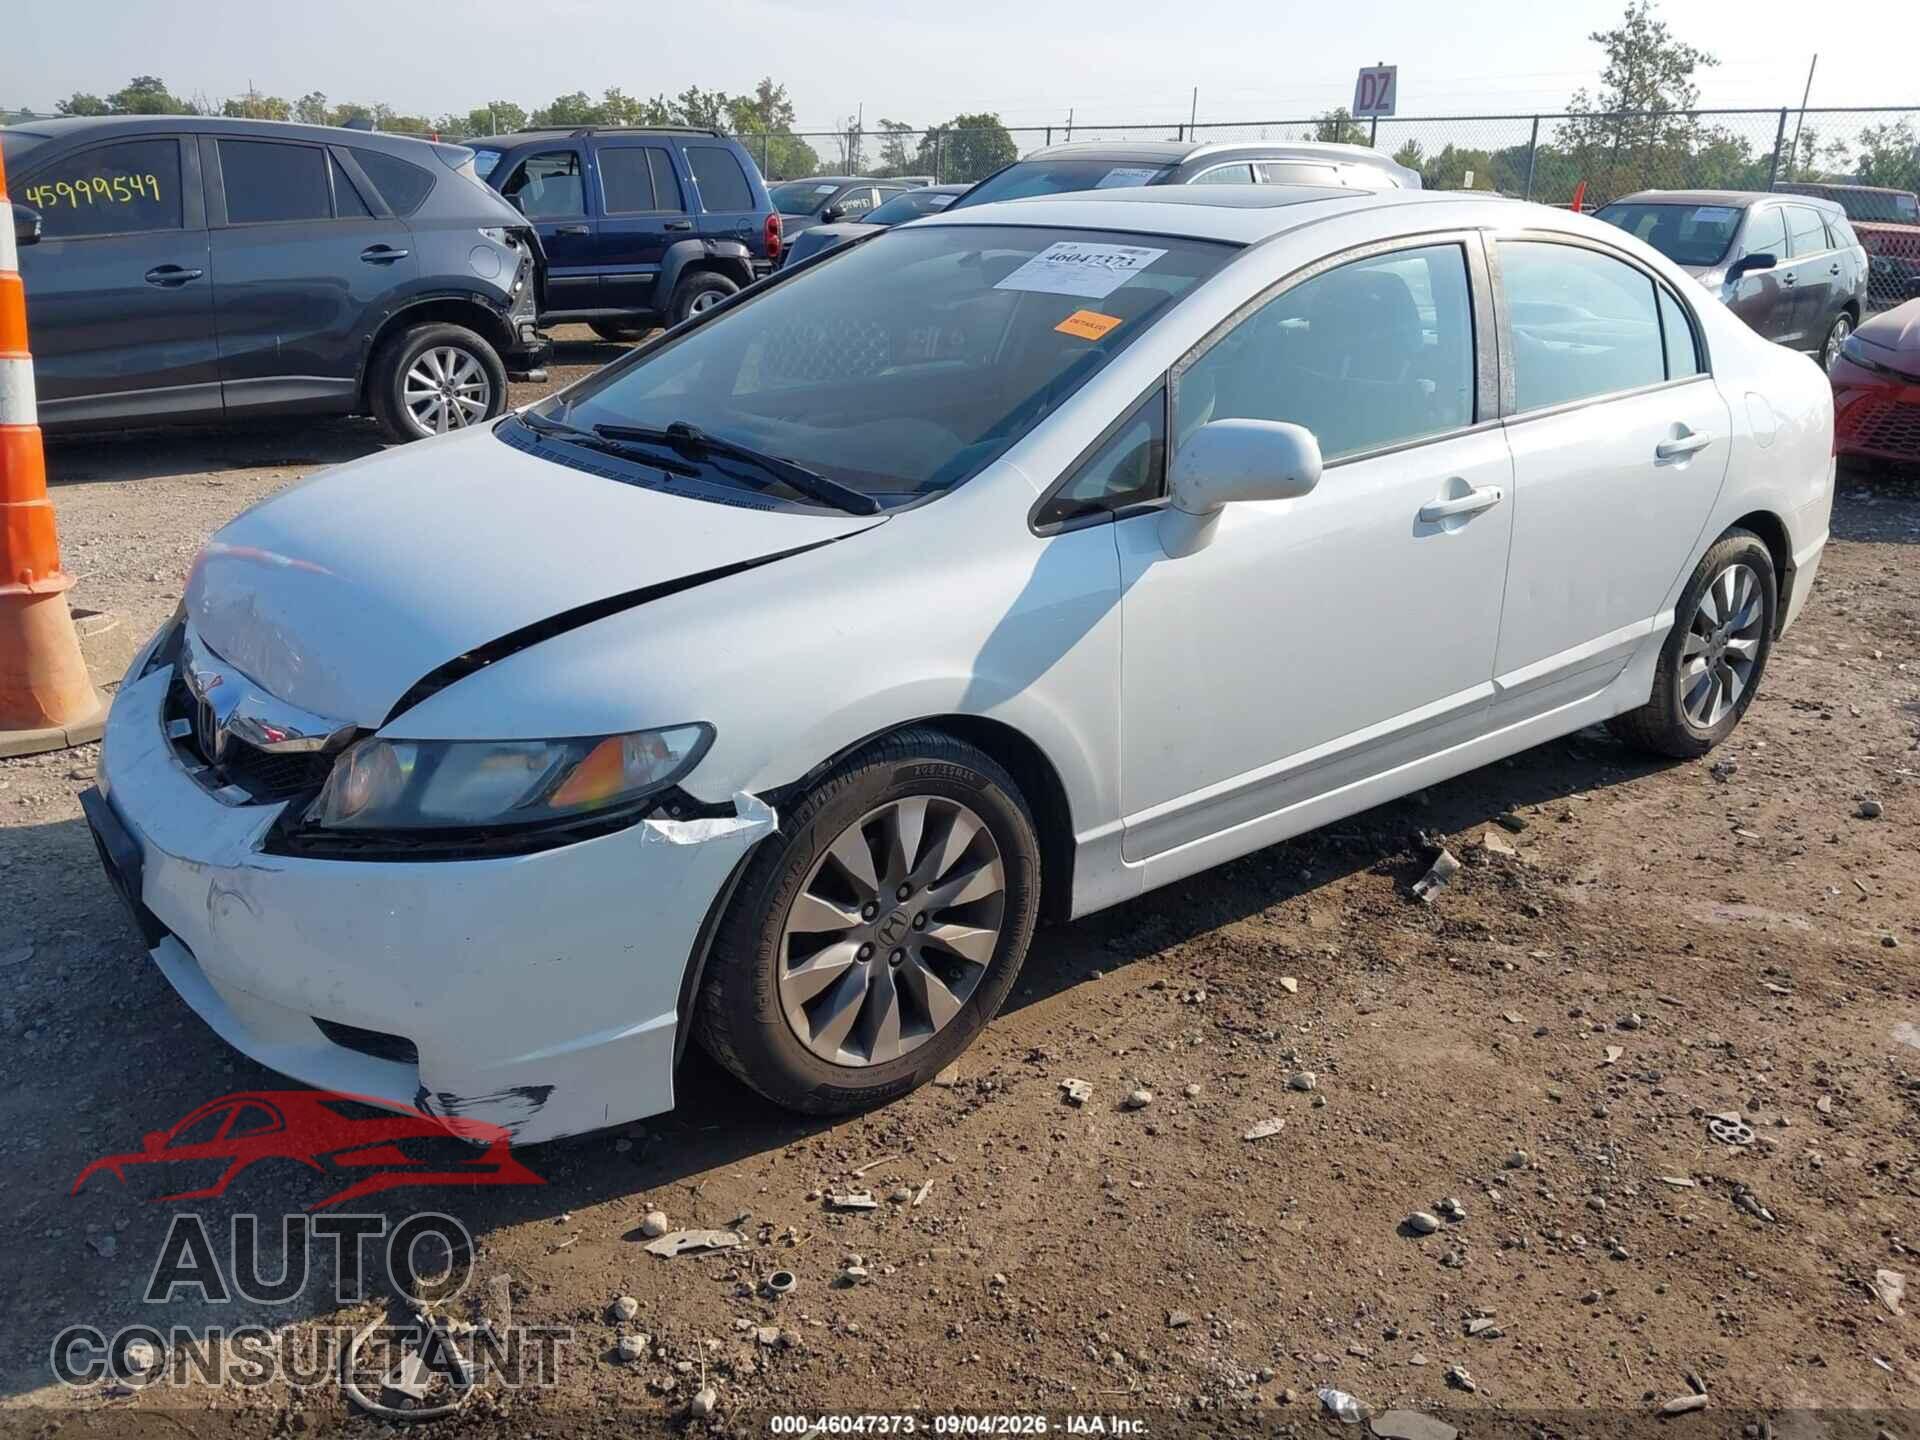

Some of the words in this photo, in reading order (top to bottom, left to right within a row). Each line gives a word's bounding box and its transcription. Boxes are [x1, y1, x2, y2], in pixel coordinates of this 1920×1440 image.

[1359, 72, 1391, 110] DZ
[27, 175, 160, 208] 45999549
[1044, 252, 1138, 267] 46047373
